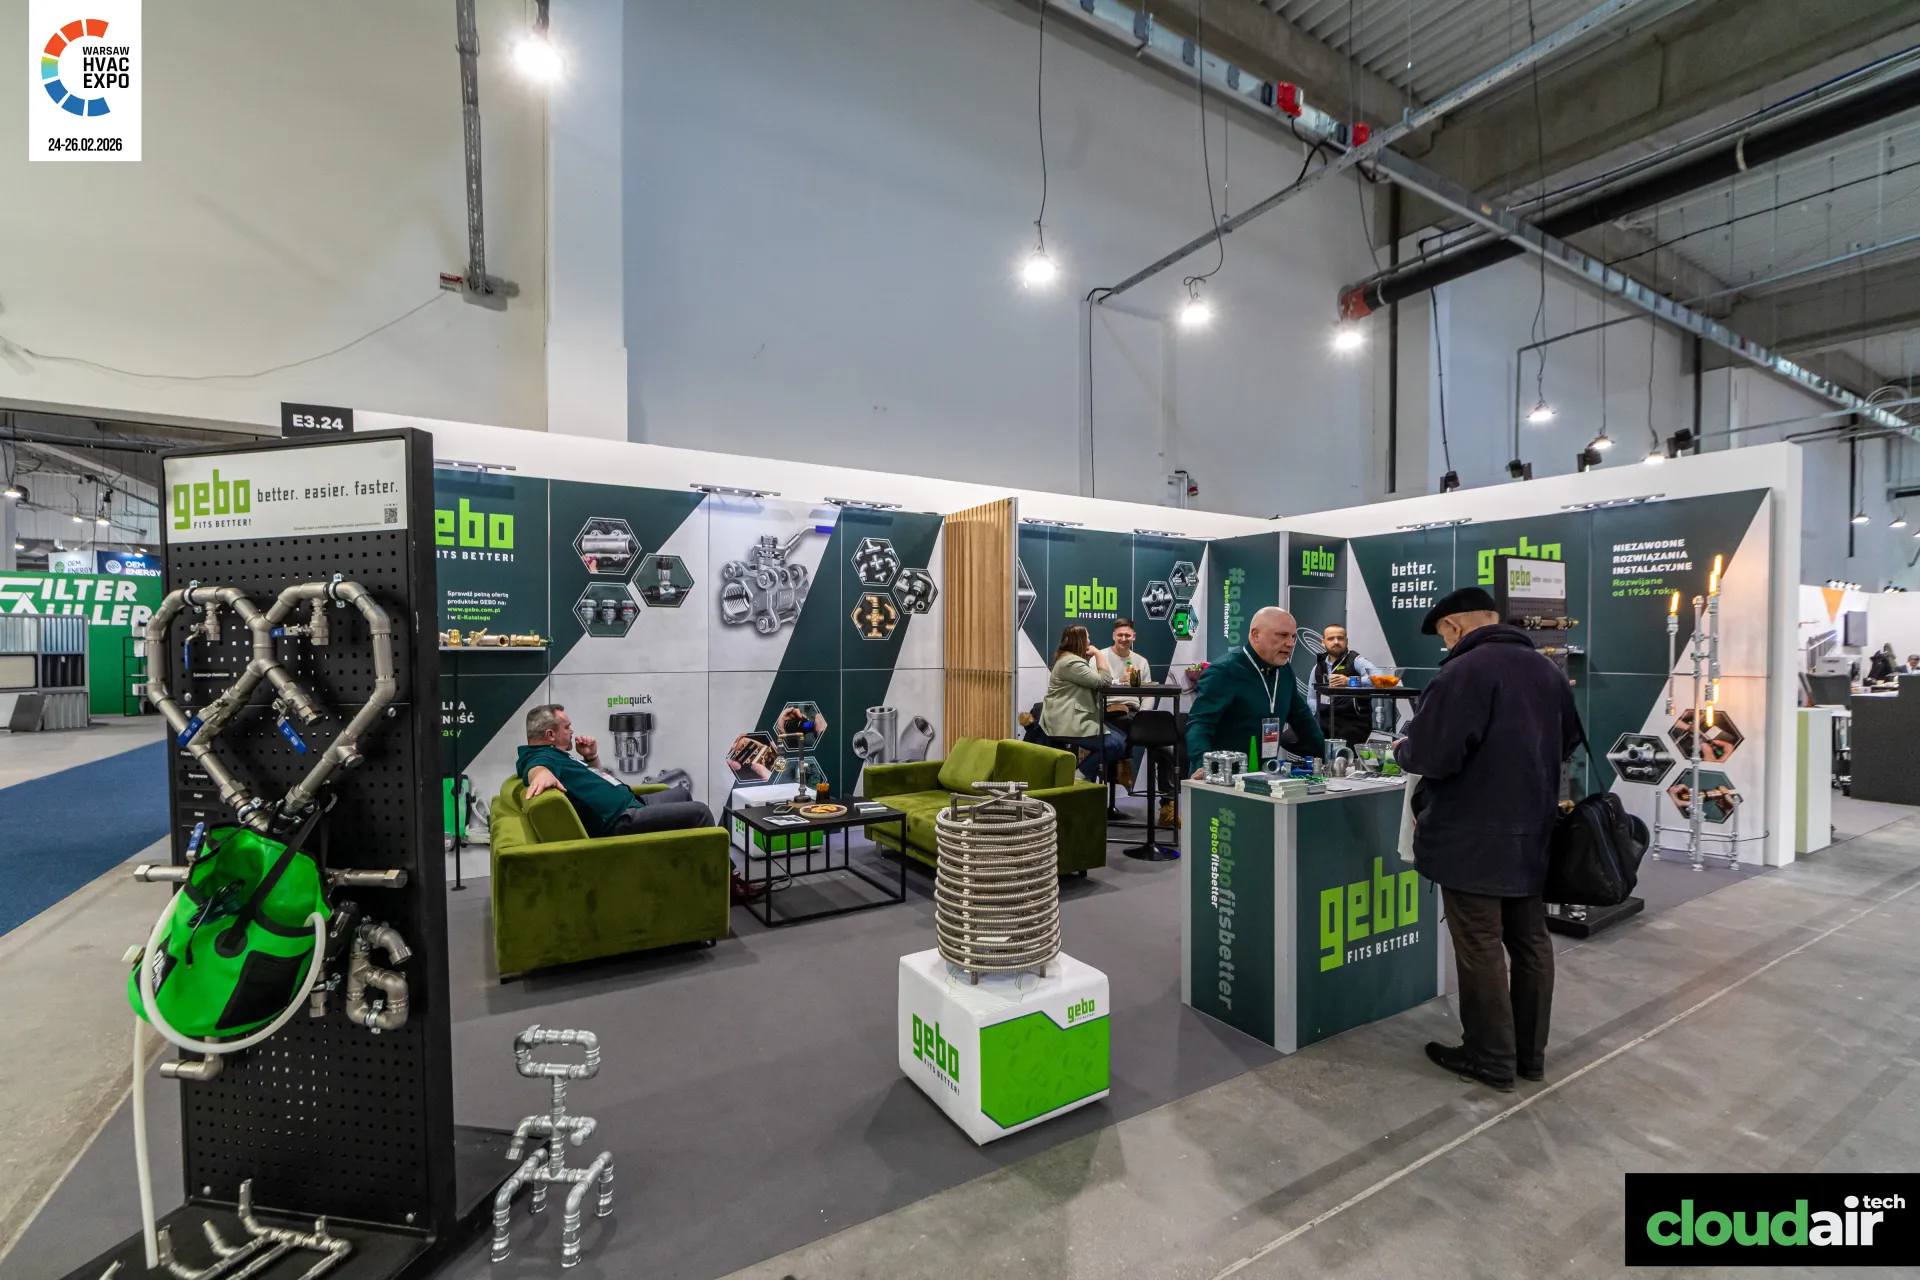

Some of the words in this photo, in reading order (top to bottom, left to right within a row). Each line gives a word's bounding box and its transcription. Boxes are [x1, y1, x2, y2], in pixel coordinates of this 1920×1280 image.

[292, 413, 344, 430] E3.24
[257, 487, 299, 503] better.
[304, 483, 349, 500] easier.
[354, 478, 399, 497] faster.
[173, 469, 250, 530] gebo
[193, 520, 213, 529] FITS
[215, 518, 252, 528] BETTER!
[434, 498, 514, 550] ebo
[1612, 539, 1686, 553] NIEZAWODNE
[436, 550, 457, 560] ITS
[462, 551, 514, 562] BETTER!
[1302, 545, 1335, 576] gebo
[1612, 551, 1689, 564] ROZWIĄZANIA
[125, 560, 146, 569] OEM
[125, 568, 162, 577] ENERGY
[1391, 561, 1437, 577] better.
[1612, 562, 1693, 575] INSTALACYJNE
[1391, 578, 1438, 593] easier.
[1509, 565, 1531, 592] gebo
[1612, 578, 1664, 587] Rozwijane
[447, 590, 473, 598] Sprawdź
[474, 591, 491, 599] pełną
[491, 591, 509, 599] ofertę
[1065, 577, 1118, 618] gebo
[1612, 589, 1625, 597] od
[1627, 587, 1651, 597] 1936
[1391, 595, 1437, 610] faster.
[457, 614, 491, 622] E-Katalogu
[607, 694, 653, 708] geboquick
[1210, 817, 1220, 908] #gebofitsbetter
[1218, 807, 1236, 1011] #gebofitsbetter
[1320, 856, 1419, 972] gebo
[1347, 945, 1373, 964] FITS
[1375, 931, 1420, 956] BETTER!
[1067, 998, 1095, 1024] gebo
[912, 1012, 960, 1083] gebo
[924, 1057, 936, 1074] FITS
[937, 1069, 960, 1096] BETTER!
